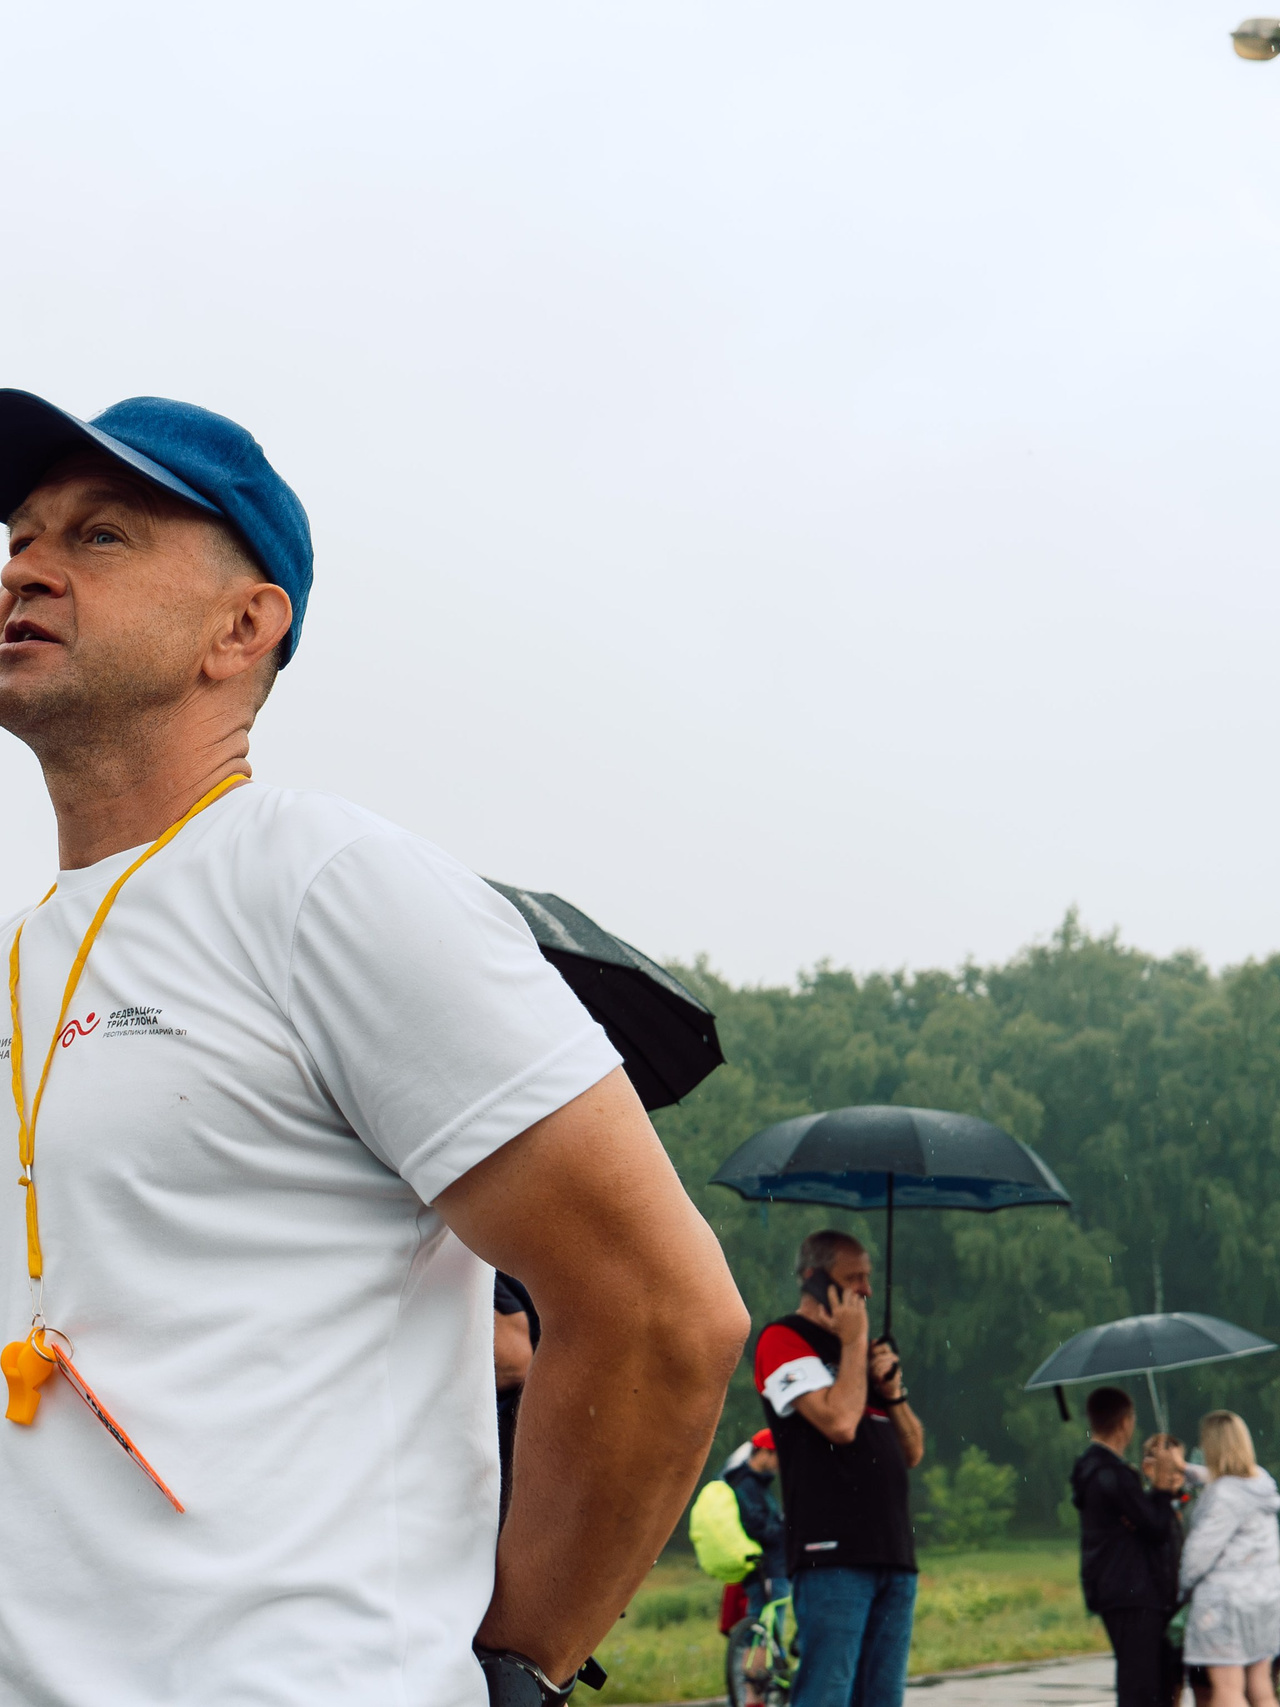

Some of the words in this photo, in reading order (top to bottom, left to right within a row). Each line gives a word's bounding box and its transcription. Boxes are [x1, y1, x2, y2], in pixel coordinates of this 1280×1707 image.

[109, 1006, 163, 1019] ФЕДЕРАЦИЯ
[106, 1016, 158, 1029] ТРИАТЛОНА
[102, 1029, 147, 1038] РЕСПУБЛИКИ
[148, 1027, 173, 1035] МАРИЙ
[174, 1028, 187, 1036] ЭЛ
